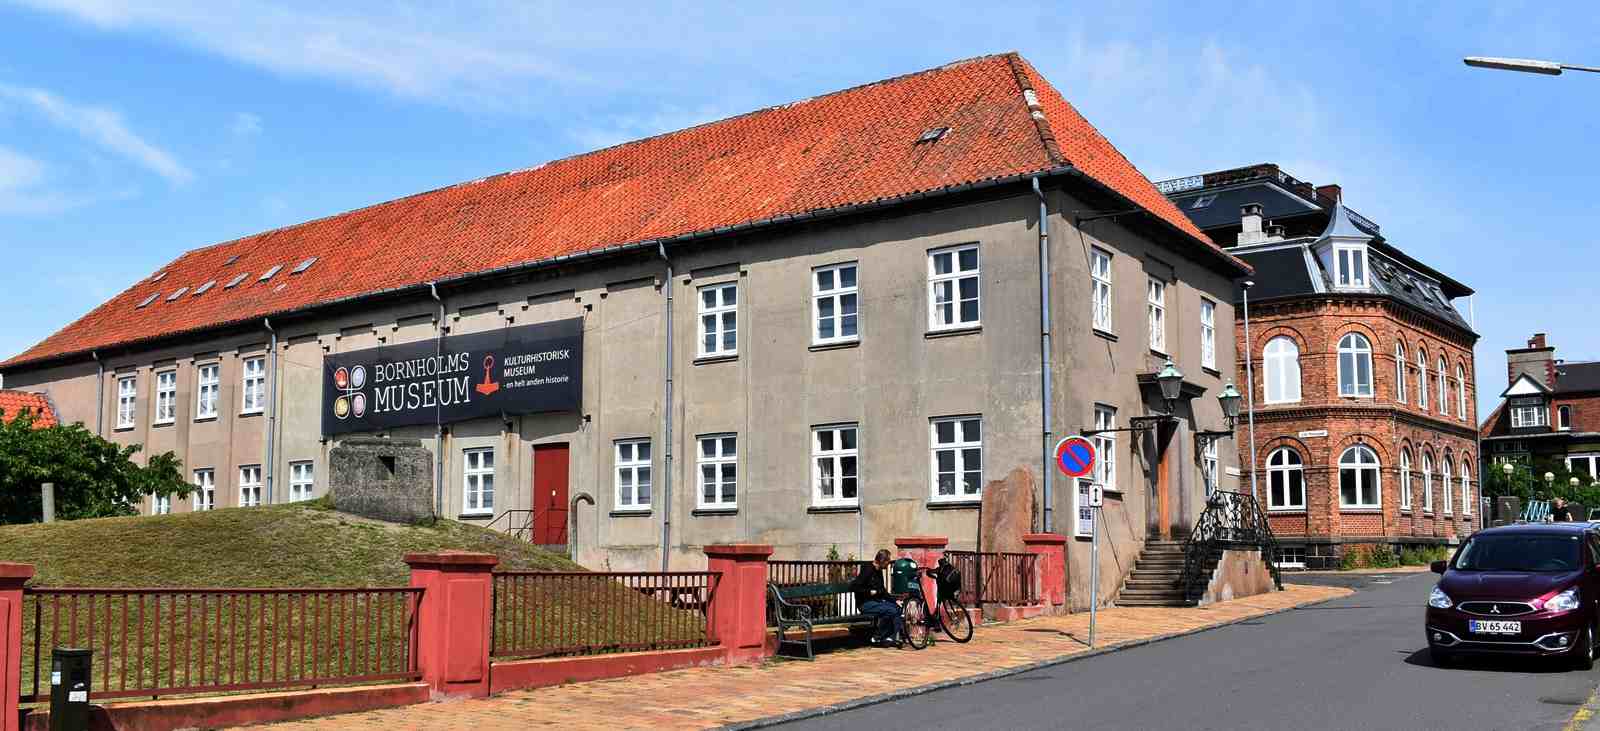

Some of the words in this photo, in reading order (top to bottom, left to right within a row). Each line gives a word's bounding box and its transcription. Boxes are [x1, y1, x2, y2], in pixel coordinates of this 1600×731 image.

[504, 349, 569, 366] KULTURHISTORISK
[375, 352, 469, 382] BORNHOLMS
[503, 366, 535, 377] MUSEUM
[514, 379, 525, 387] helt
[526, 377, 544, 386] anden
[545, 375, 568, 384] historie
[373, 376, 470, 412] MUSEUM
[1476, 622, 1487, 630] BV
[1490, 623, 1500, 631] 65
[1502, 623, 1519, 631] 442
